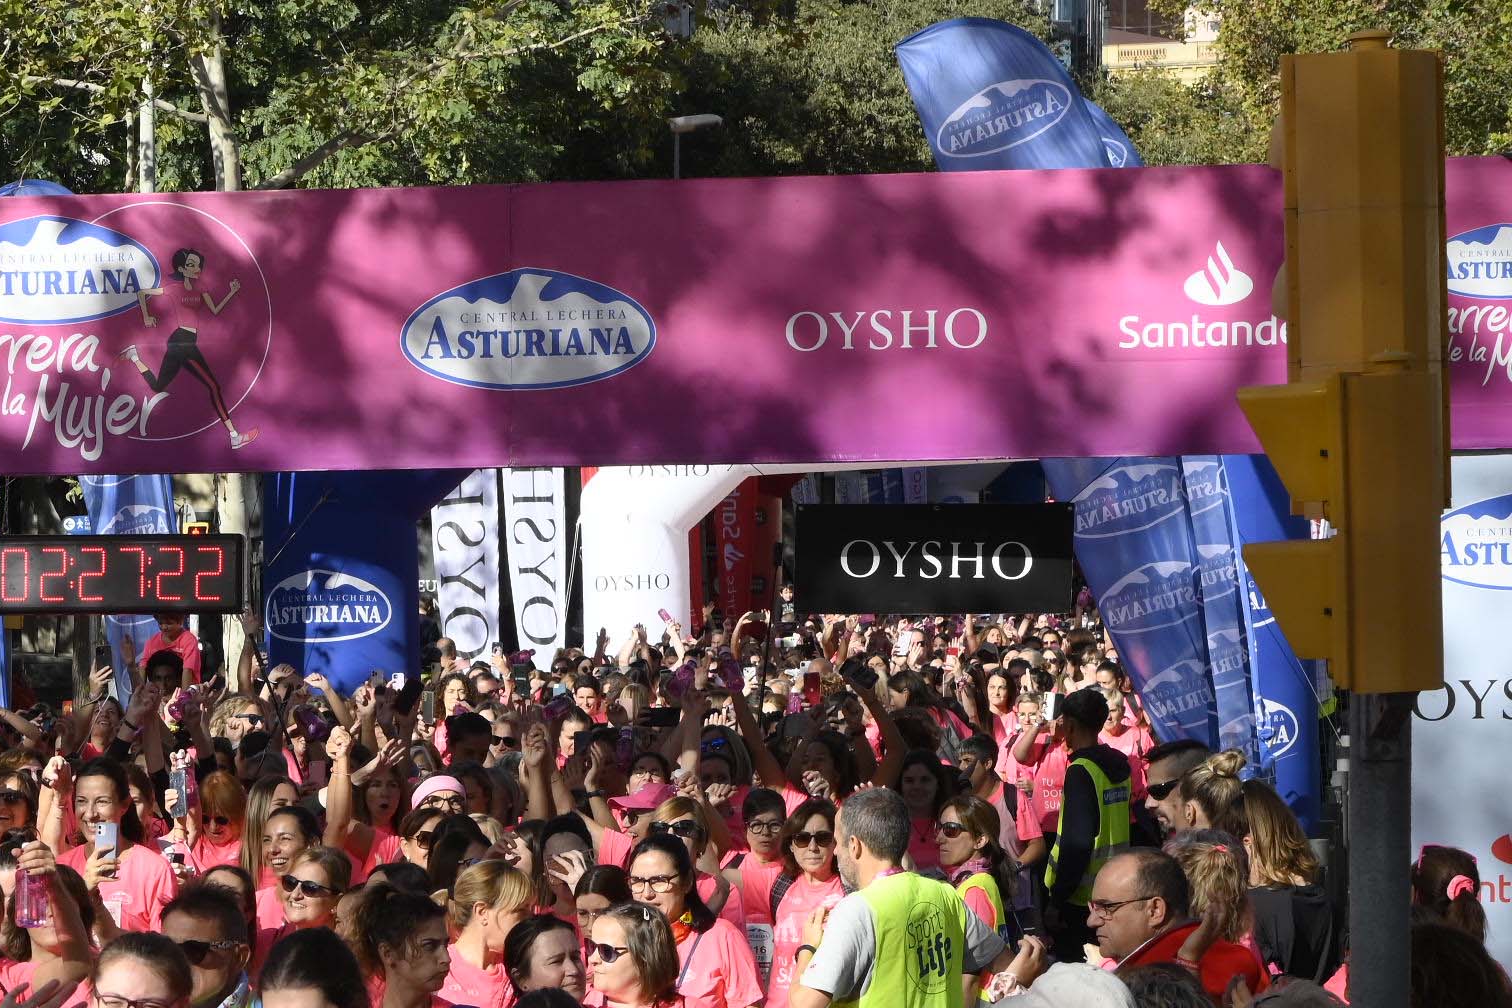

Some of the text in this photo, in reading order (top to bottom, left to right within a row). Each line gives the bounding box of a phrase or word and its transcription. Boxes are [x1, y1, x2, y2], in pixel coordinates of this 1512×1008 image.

[460, 309, 627, 323] CENTRAL LECHERA
[785, 308, 988, 351] OYSHO
[1119, 314, 1288, 349] Santande
[421, 316, 636, 360] ASTURIANA
[1, 376, 26, 416] la
[21, 367, 170, 461] Mujer
[1, 547, 223, 601] 02:27:22
[840, 539, 1034, 581] OYSHO
[595, 573, 670, 592] OYSHO
[269, 600, 383, 627] ASTURIANA
[908, 908, 943, 949] Sport
[917, 932, 952, 978] Life
